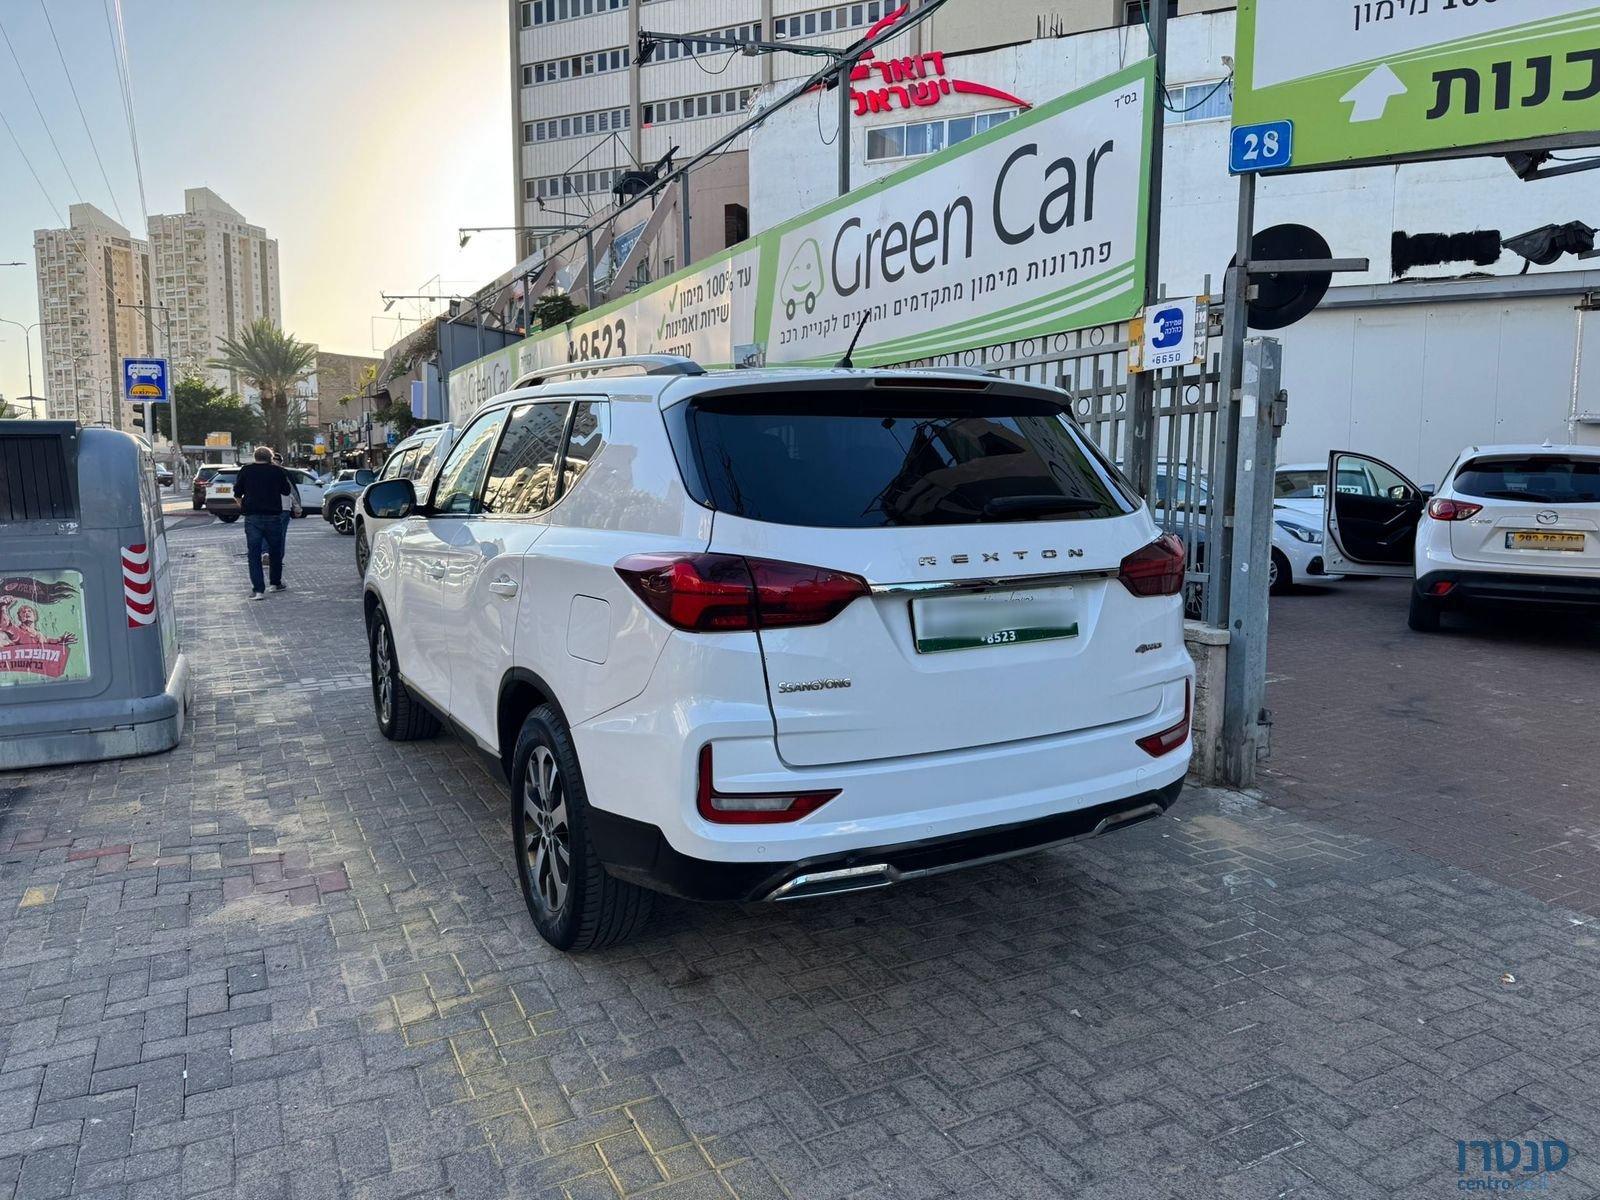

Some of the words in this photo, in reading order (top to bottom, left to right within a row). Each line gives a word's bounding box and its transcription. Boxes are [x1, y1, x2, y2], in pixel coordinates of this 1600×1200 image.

[871, 51, 945, 84] דואר
[850, 78, 950, 116] ישראל
[1243, 130, 1279, 161] 28
[832, 195, 973, 297] Green
[992, 140, 1114, 245] Car
[1026, 241, 1112, 282] פתרונות
[706, 270, 734, 299] 100%
[737, 266, 752, 288] עד
[971, 267, 1018, 301] מימון
[680, 285, 703, 314] מימון
[893, 283, 963, 316] מתקדמים
[665, 313, 698, 340] ואמינות
[700, 303, 730, 329] שירות
[801, 314, 838, 340] לקניית
[780, 328, 798, 345] רכב
[919, 548, 1084, 566] REXTON
[15, 648, 61, 662] מהפכת
